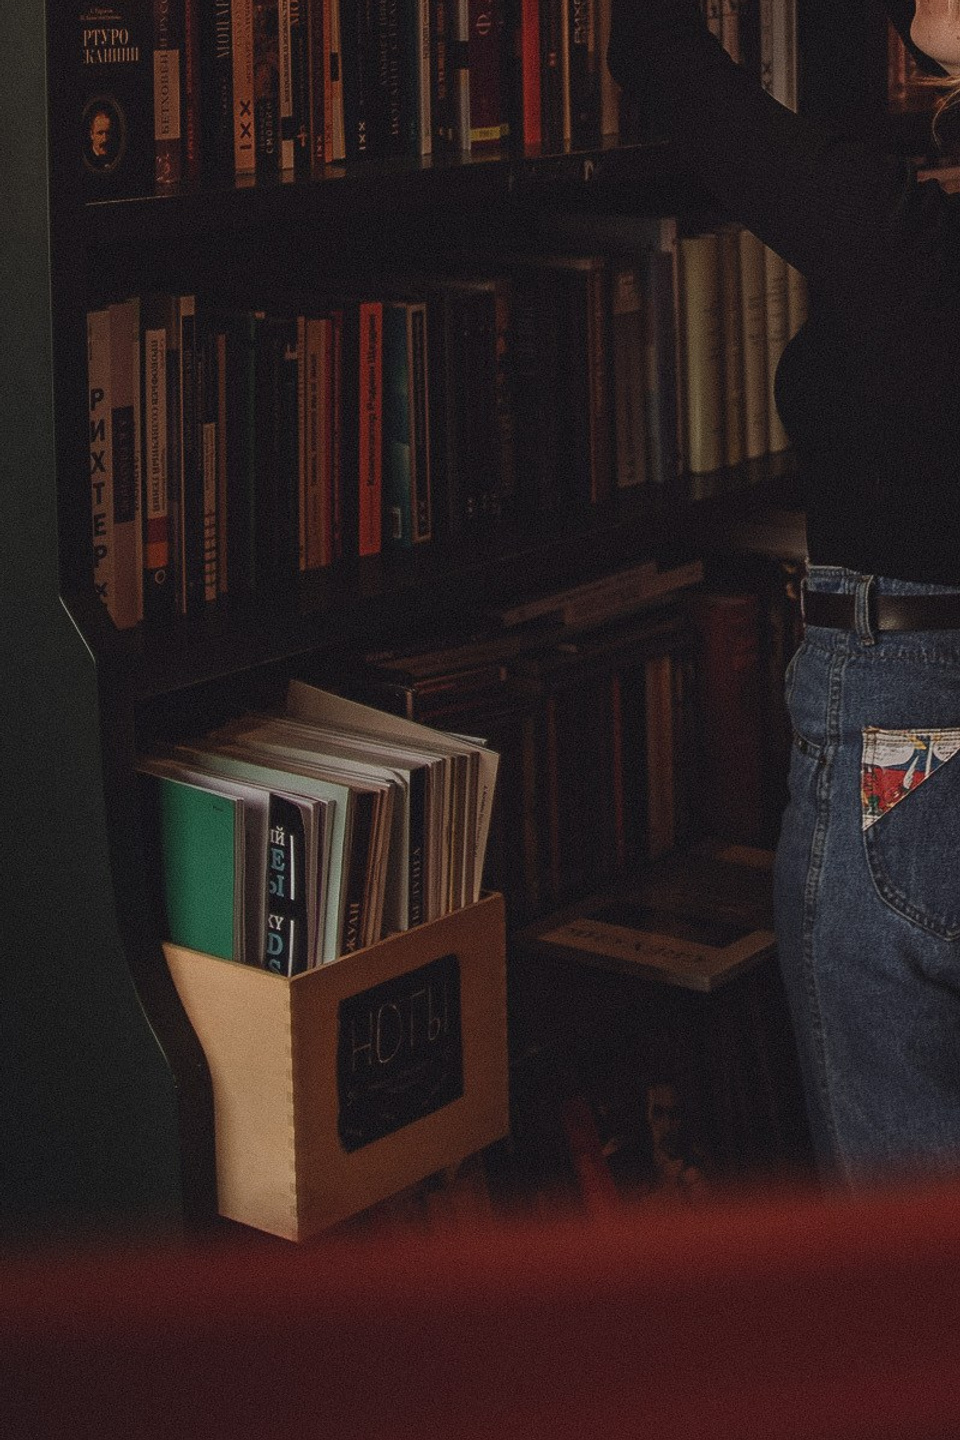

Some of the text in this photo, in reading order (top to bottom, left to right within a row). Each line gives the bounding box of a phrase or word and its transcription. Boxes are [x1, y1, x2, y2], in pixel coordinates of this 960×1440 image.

[82, 28, 129, 47] РТУРО
[475, 11, 492, 36] Ф.
[82, 46, 140, 64] КАНИНИ
[159, 53, 170, 135] БЕТХОВЕН
[239, 99, 252, 151] XXI
[266, 101, 274, 155] СМОЛИН
[150, 339, 160, 406] ПРОКОФЬЕВ
[90, 387, 109, 568] РИХТЕР
[351, 978, 449, 1073] НОТЫ
